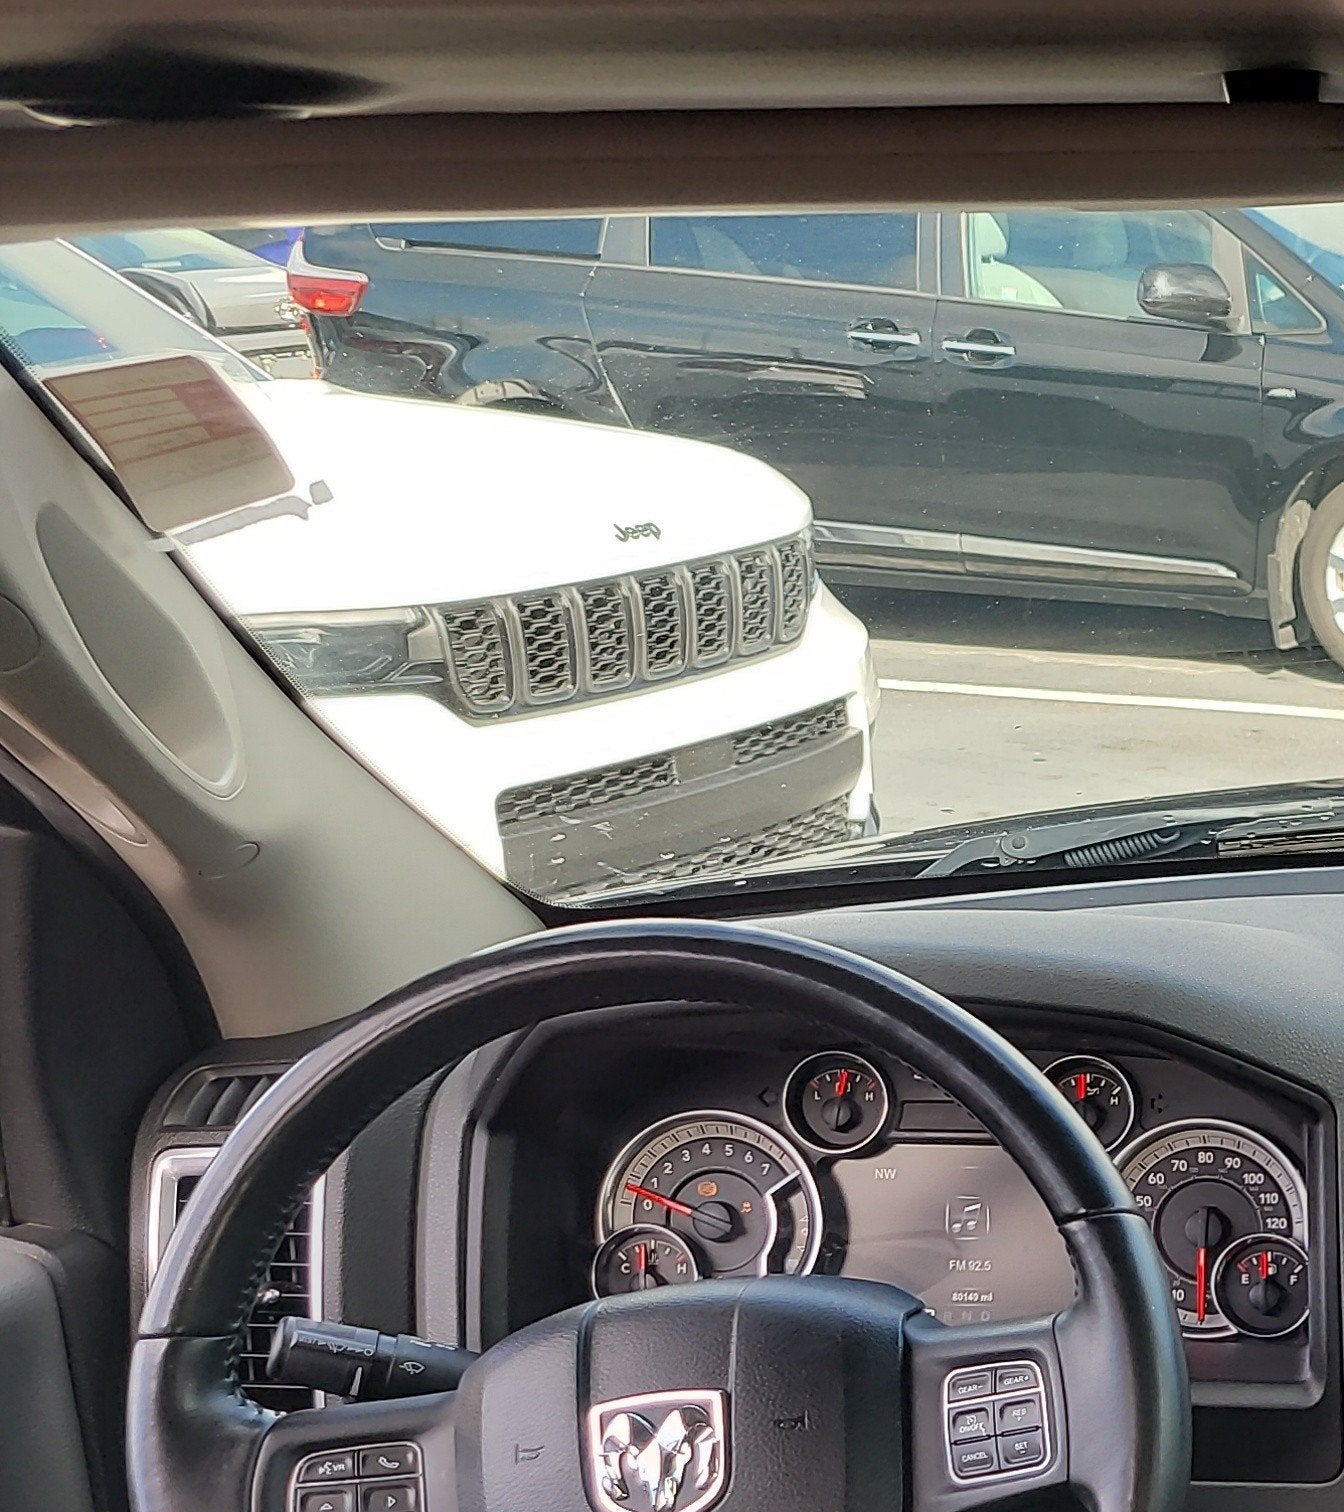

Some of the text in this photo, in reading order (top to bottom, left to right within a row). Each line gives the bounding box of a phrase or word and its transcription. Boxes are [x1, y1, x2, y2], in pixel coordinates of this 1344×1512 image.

[613, 522, 661, 542] Jeep
[814, 1090, 822, 1100] L
[865, 1091, 874, 1101] H
[1109, 1096, 1119, 1106] H
[702, 1143, 711, 1155] 4
[724, 1145, 734, 1157] 5
[682, 1150, 691, 1162] 3
[744, 1151, 754, 1163] 6
[1198, 1151, 1214, 1164] 80
[663, 1162, 673, 1174] 2
[761, 1163, 771, 1175] 7
[1171, 1159, 1188, 1172] 70
[1224, 1157, 1241, 1169] 90
[874, 1168, 897, 1180] NW
[1148, 1172, 1165, 1185] 60
[1242, 1173, 1265, 1185] 100
[651, 1178, 658, 1189] 1
[1136, 1195, 1152, 1207] 50
[1258, 1192, 1279, 1204] 110
[643, 1199, 653, 1211] 0
[1265, 1217, 1287, 1229] 120
[621, 1263, 632, 1275] C
[677, 1263, 687, 1275] H
[949, 1259, 992, 1271] FM 92.5
[1241, 1274, 1249, 1285] E
[1290, 1274, 1298, 1286] F
[1172, 1289, 1185, 1301] 10
[961, 1450, 988, 1463] CANCEL
